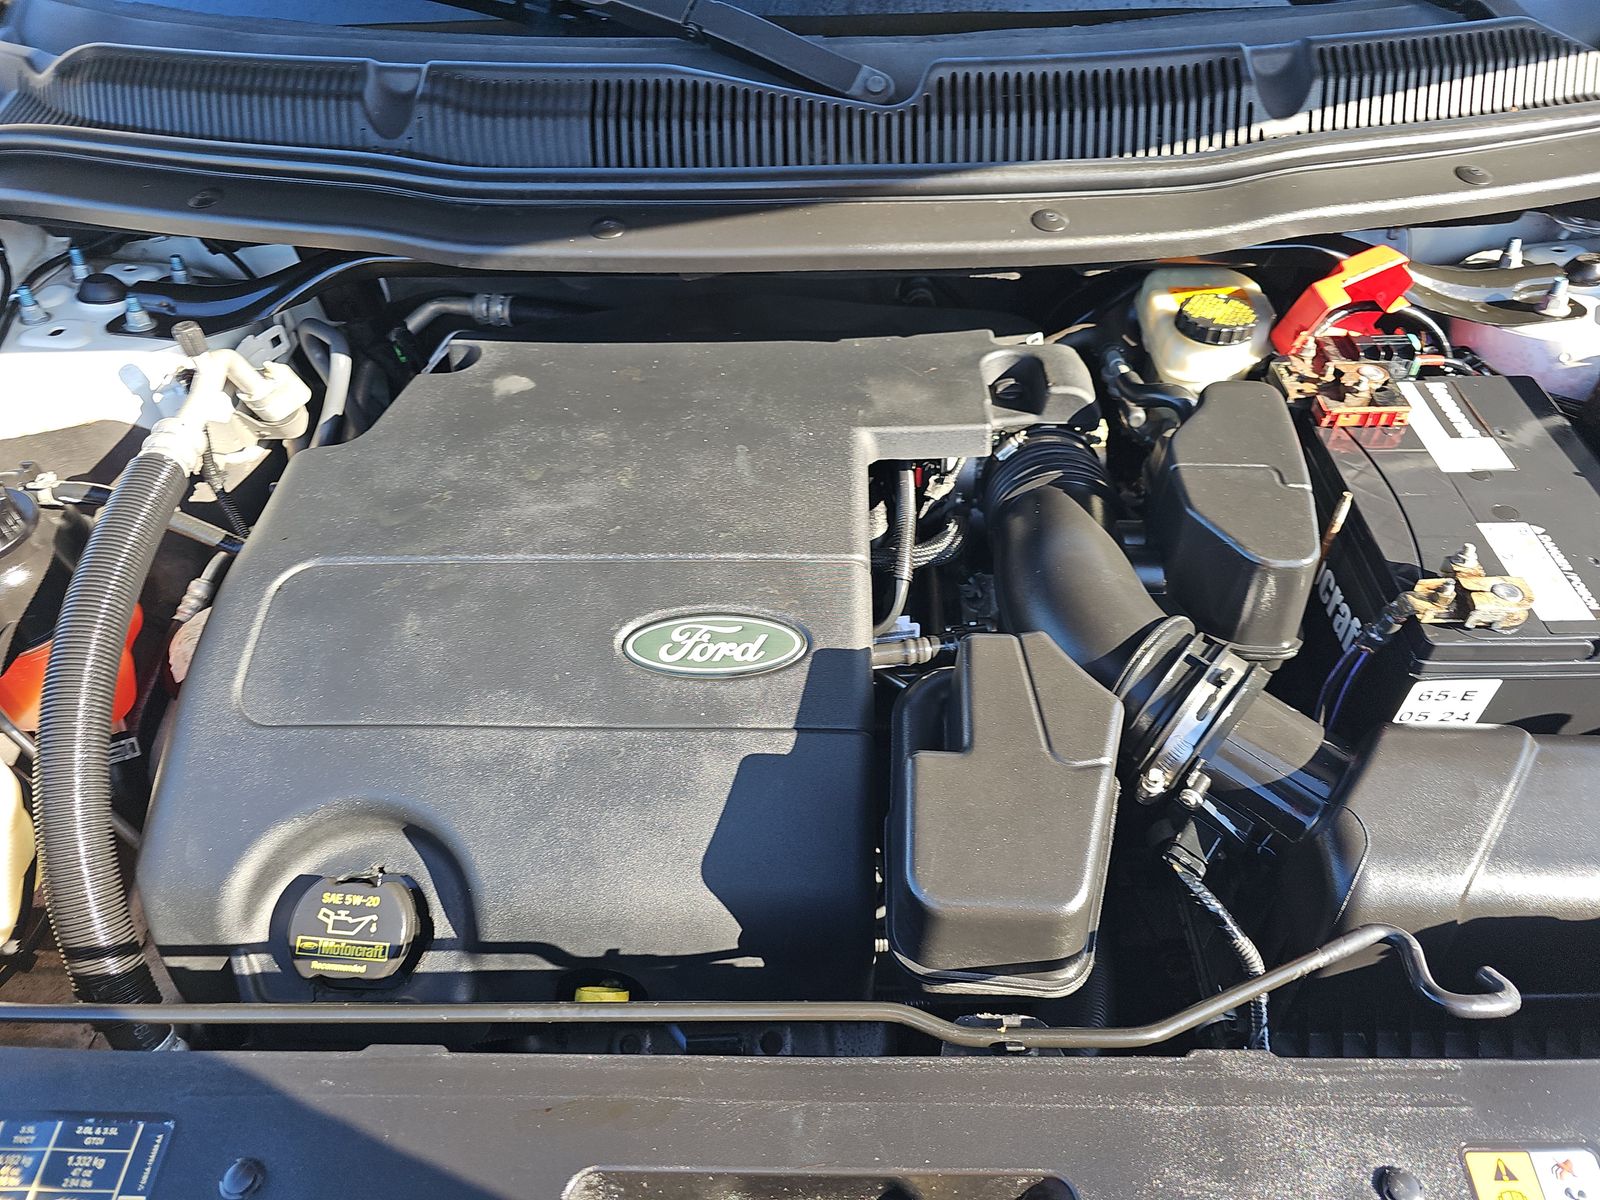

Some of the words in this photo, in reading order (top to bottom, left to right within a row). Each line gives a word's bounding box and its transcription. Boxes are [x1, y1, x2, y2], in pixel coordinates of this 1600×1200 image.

[658, 624, 769, 662] Ford
[1418, 690, 1478, 702] 65-E
[1398, 711, 1431, 722] 05
[1438, 711, 1470, 722] 24
[321, 892, 344, 905] SAE
[345, 894, 381, 907] 5W-20
[321, 940, 385, 959] Motorcraft
[92, 1156, 107, 1169] kg
